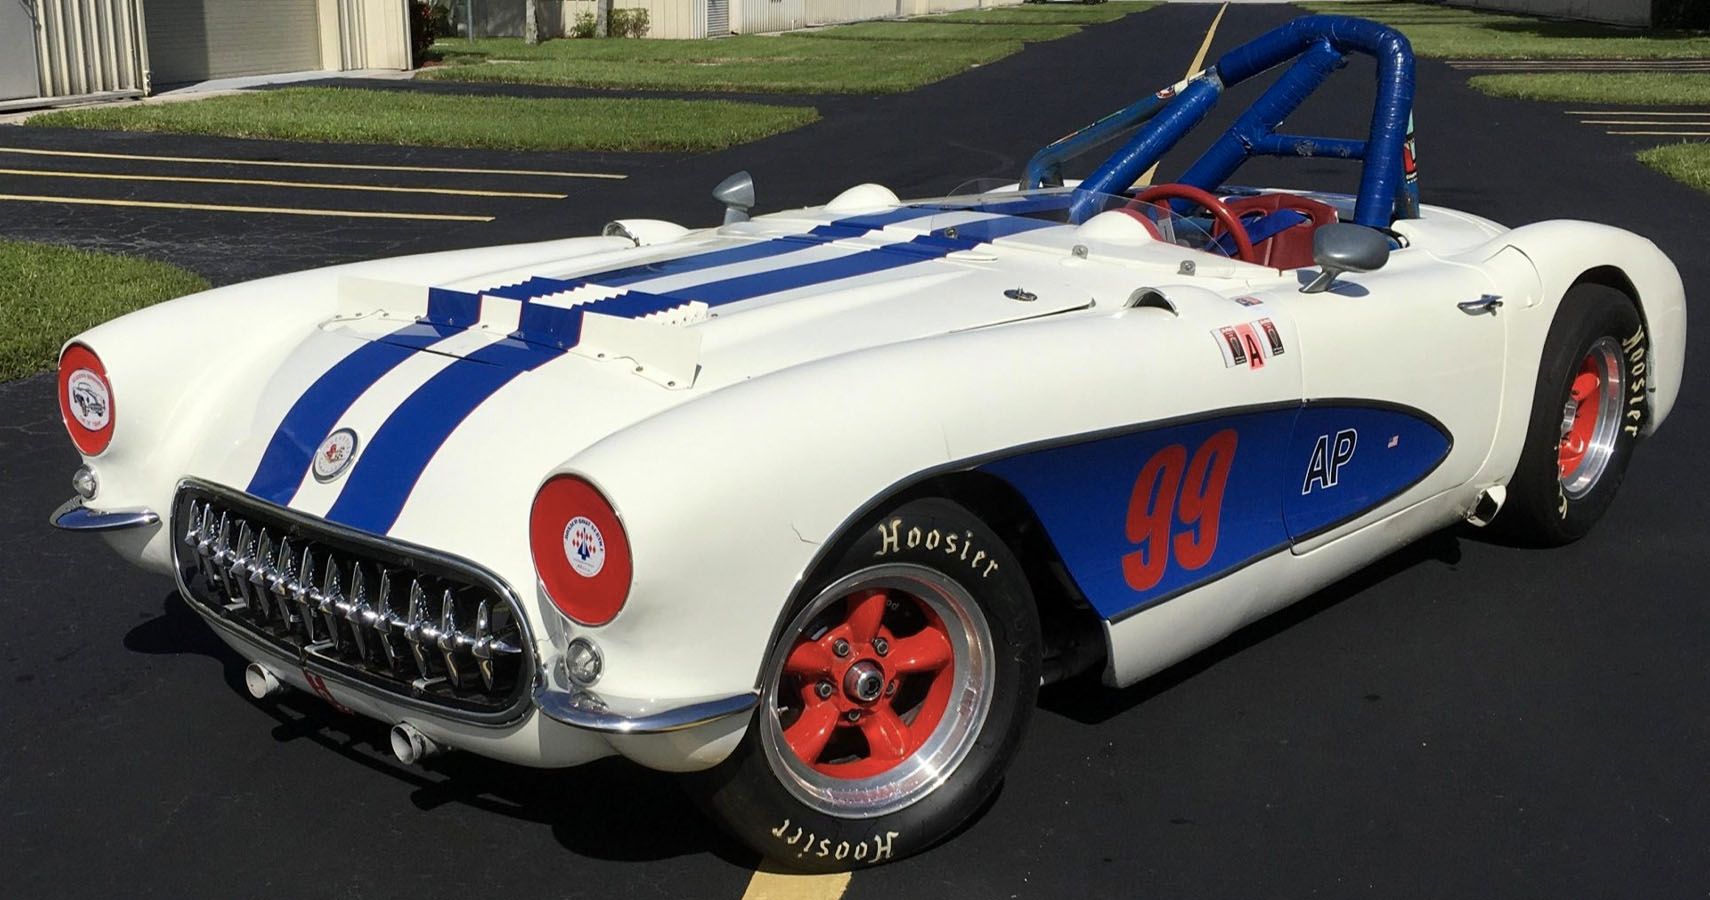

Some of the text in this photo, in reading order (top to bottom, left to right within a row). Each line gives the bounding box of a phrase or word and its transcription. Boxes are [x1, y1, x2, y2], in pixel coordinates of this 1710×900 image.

[1245, 333, 1264, 368] A
[1621, 324, 1646, 439] Hoosier
[1301, 428, 1358, 495] AP
[1121, 427, 1239, 592] 99
[874, 518, 999, 578] Hoosier
[771, 818, 900, 864] Hoosier
